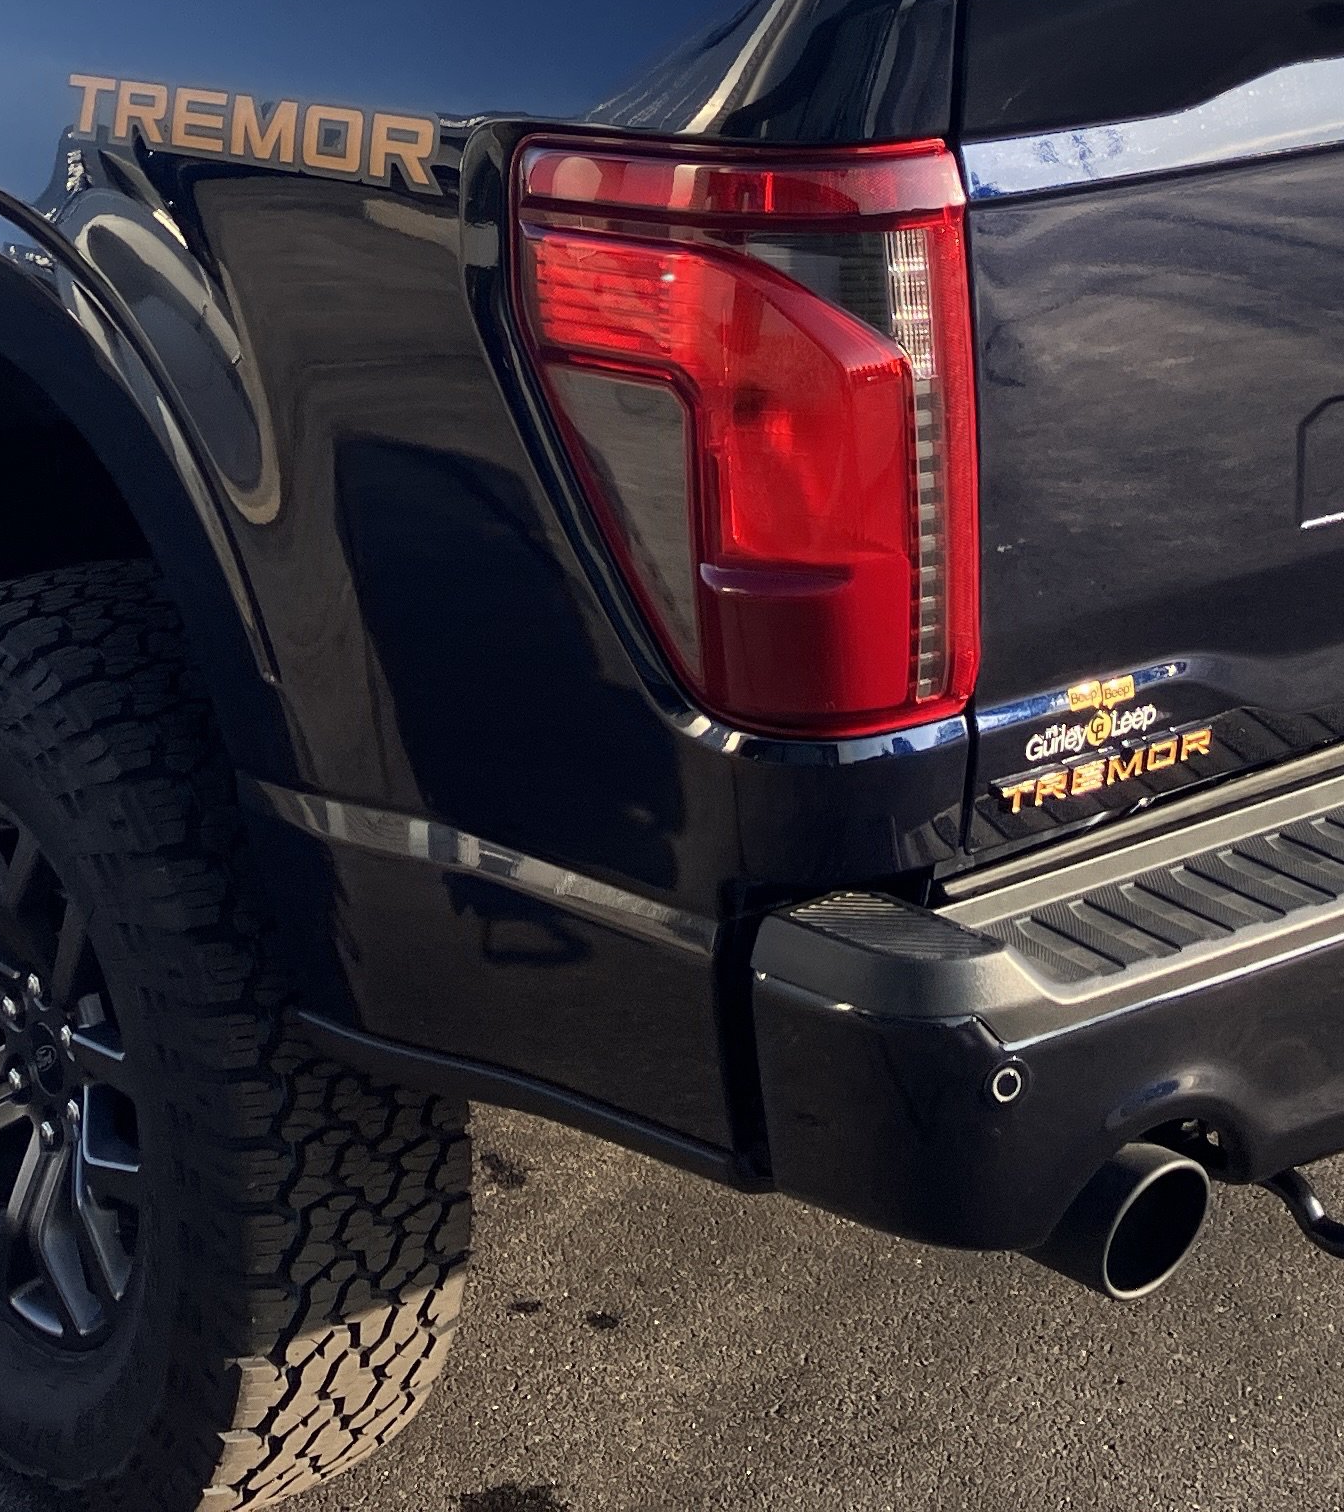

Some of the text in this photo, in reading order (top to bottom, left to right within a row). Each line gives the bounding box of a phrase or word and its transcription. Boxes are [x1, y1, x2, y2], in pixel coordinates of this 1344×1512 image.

[68, 72, 438, 189] TREMOR
[1002, 728, 1213, 814] TREMOR
[1026, 704, 1156, 761] Gurley Leep
